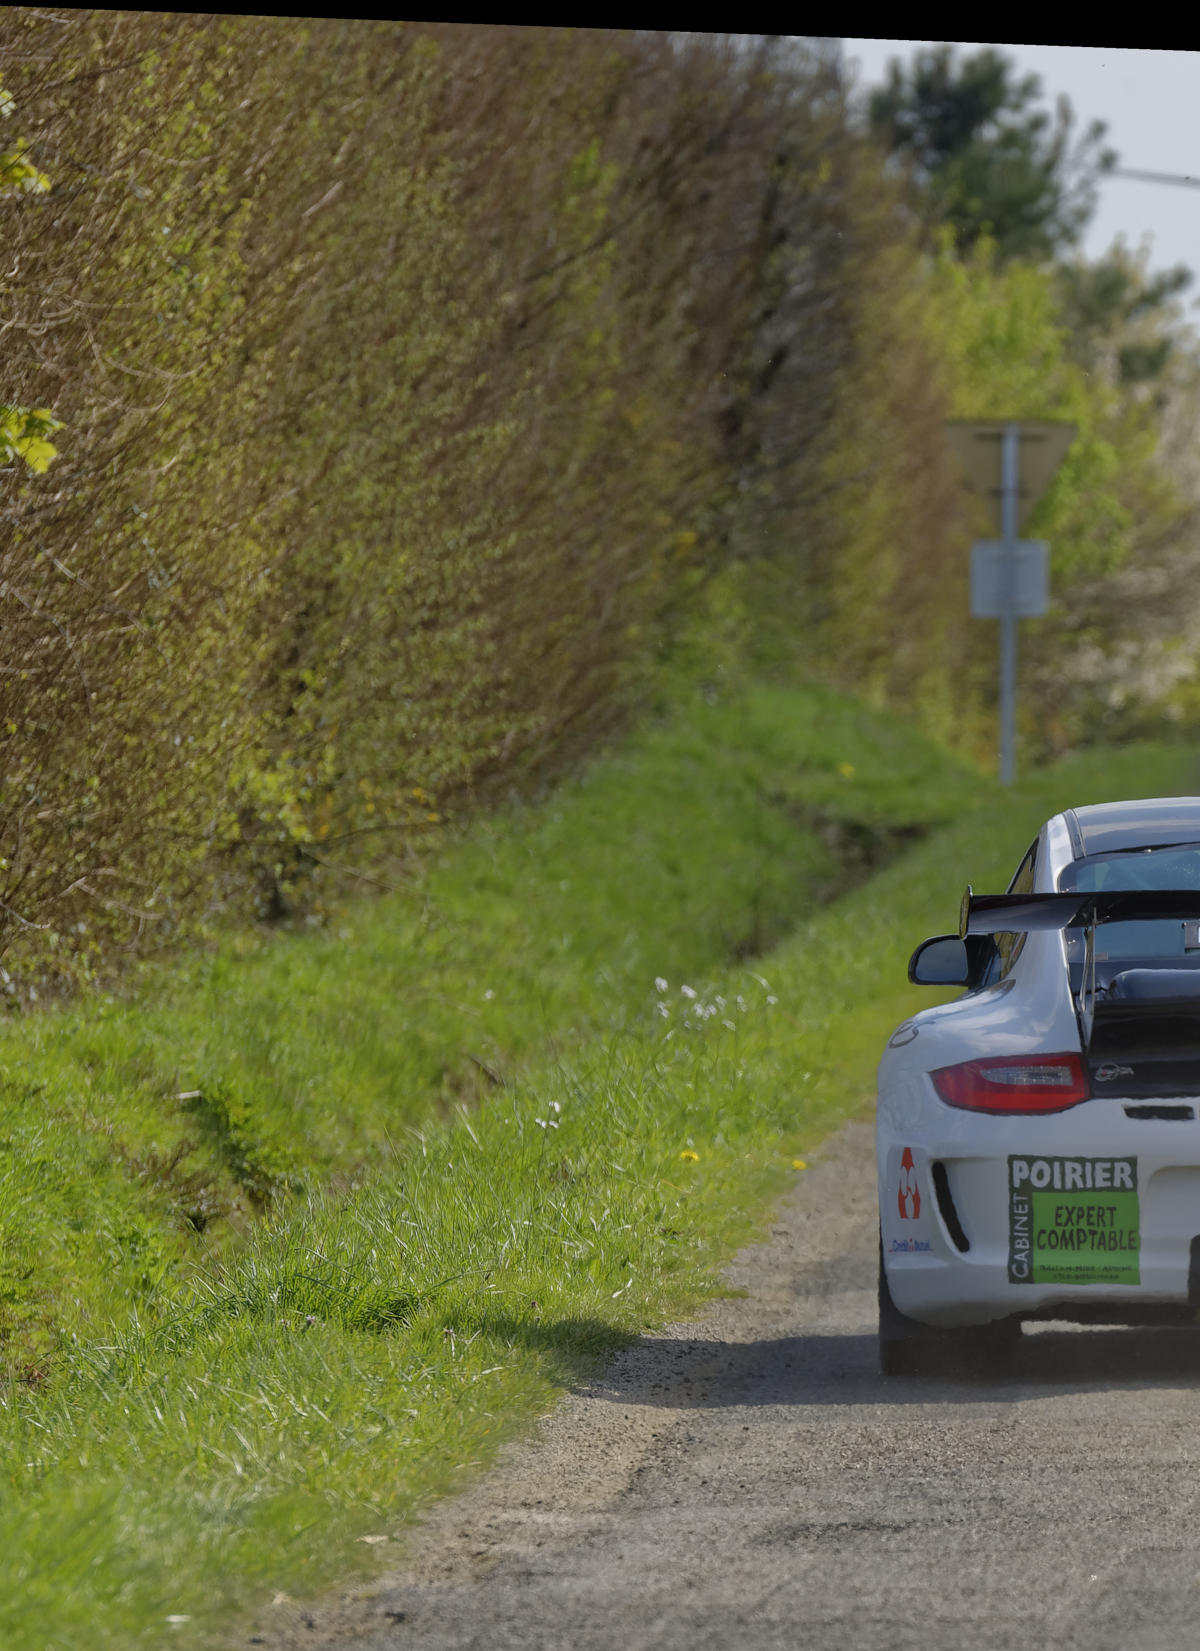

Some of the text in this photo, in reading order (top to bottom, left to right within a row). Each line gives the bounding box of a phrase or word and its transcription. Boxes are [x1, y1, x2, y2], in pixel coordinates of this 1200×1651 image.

[1013, 1160, 1134, 1190] POIRIER
[1054, 1206, 1117, 1227] EXPERT
[1012, 1192, 1030, 1278] CABINET
[1036, 1228, 1138, 1251] COMPTABLE
